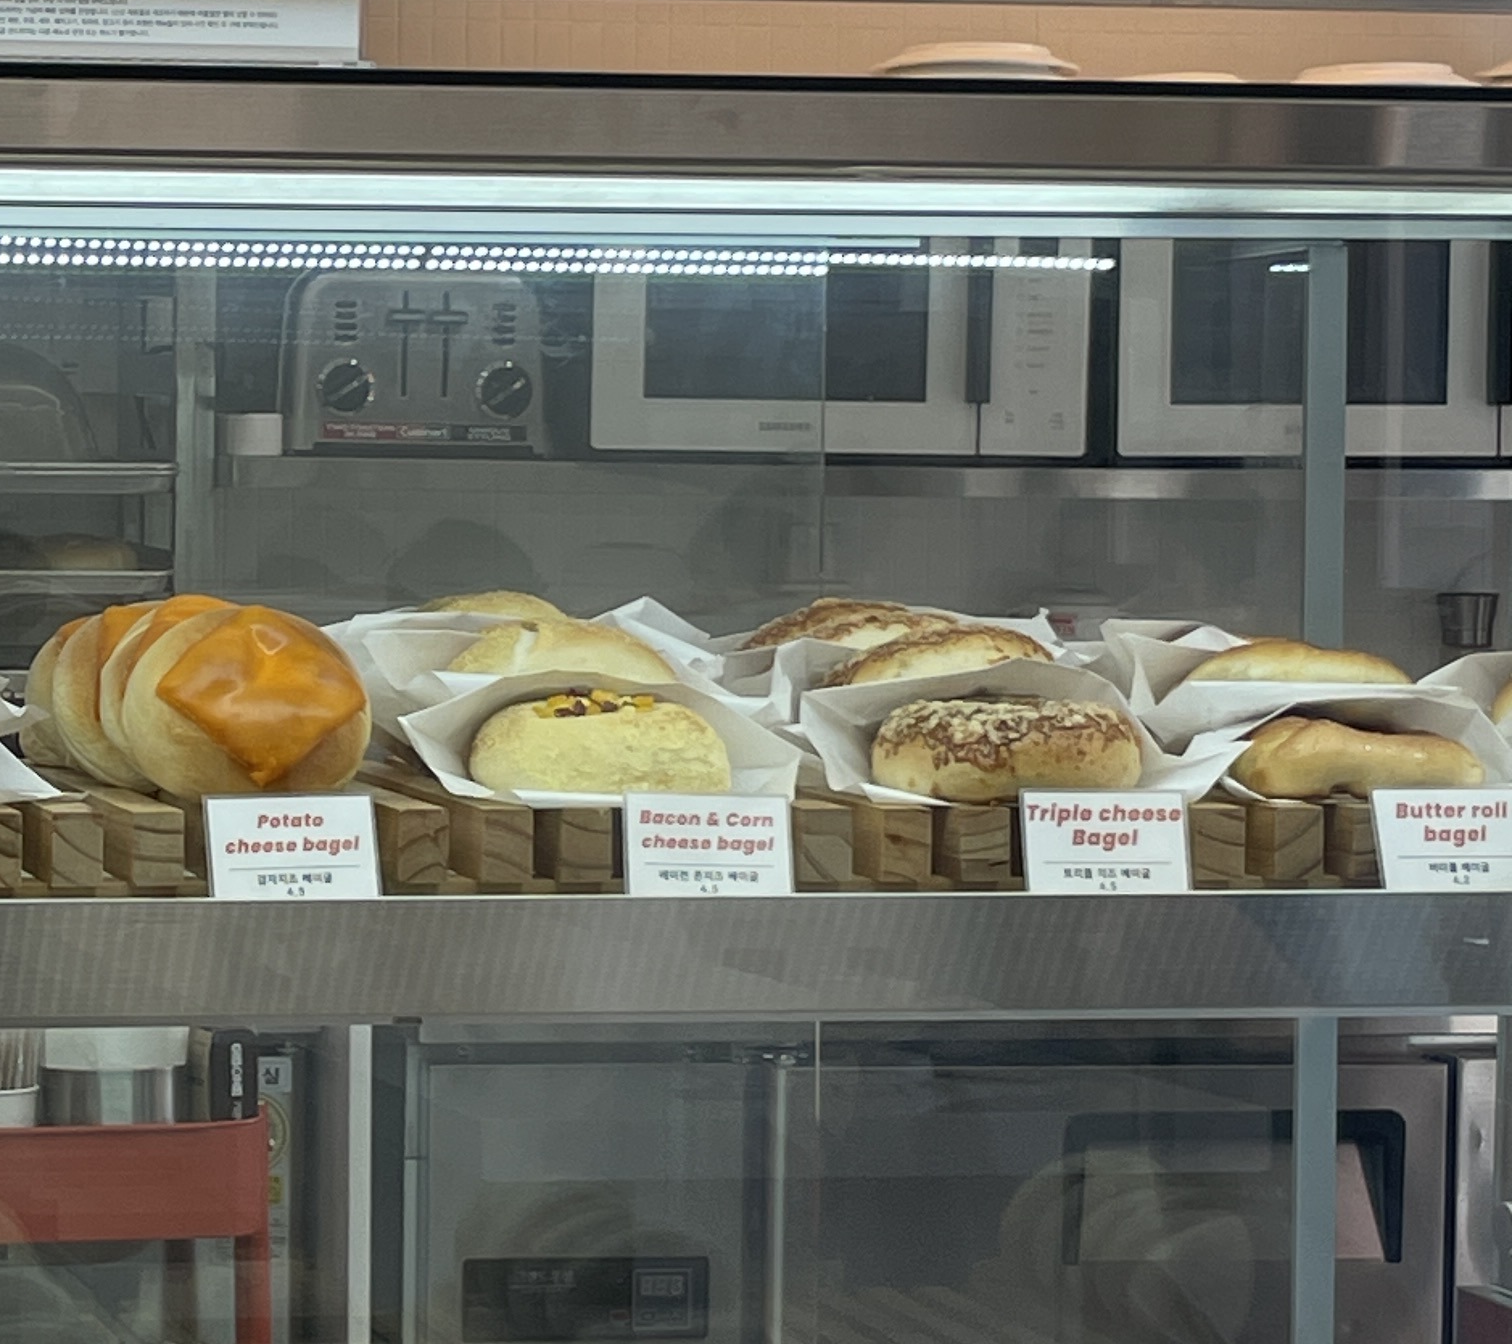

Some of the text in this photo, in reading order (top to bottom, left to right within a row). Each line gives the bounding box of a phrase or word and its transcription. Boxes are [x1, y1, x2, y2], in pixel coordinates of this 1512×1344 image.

[639, 810, 774, 827] Bacon & Corn
[1027, 803, 1181, 827] Triple cheese
[1396, 802, 1508, 819] Butter roll
[257, 814, 324, 828] Potato
[225, 836, 359, 855] cheese bagel
[642, 835, 774, 855] cheese bagel
[1072, 829, 1138, 851] Bagel
[1424, 825, 1486, 847] bagel
